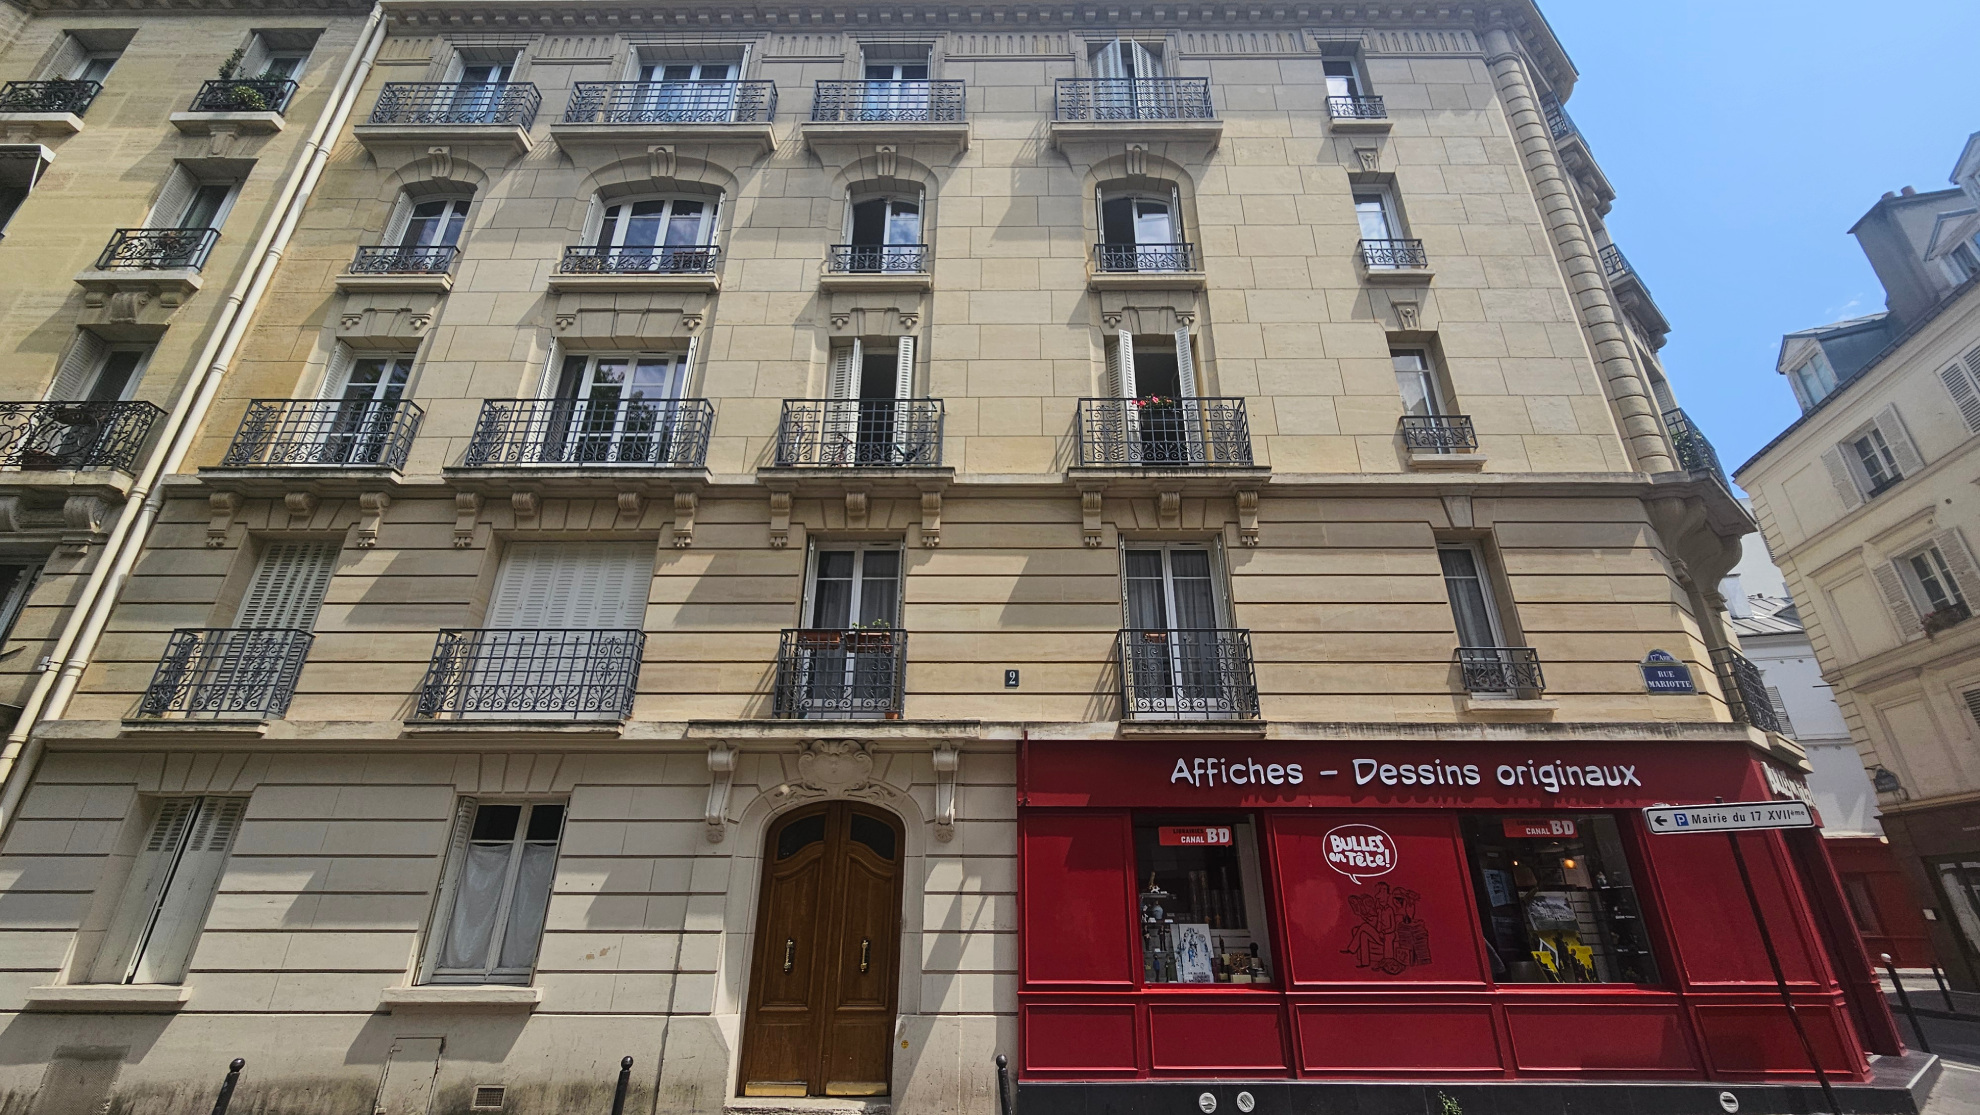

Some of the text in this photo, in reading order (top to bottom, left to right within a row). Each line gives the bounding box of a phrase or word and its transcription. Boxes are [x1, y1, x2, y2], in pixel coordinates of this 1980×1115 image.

[1008, 670, 1016, 685] 2
[1657, 670, 1675, 678] RUE
[1647, 680, 1692, 688] MARIOTTE
[1170, 757, 1303, 788] Affiches
[1353, 758, 1482, 786] Dessins
[1496, 758, 1642, 793] originaux
[1691, 813, 1728, 825] Mairie
[1732, 812, 1746, 823] du
[1750, 811, 1762, 822] 17
[1525, 827, 1550, 835] CANAL
[1550, 820, 1575, 835] BD
[1180, 828, 1230, 844] CANAL BD
[1329, 834, 1385, 853] BULLES
[1328, 851, 1347, 863] en
